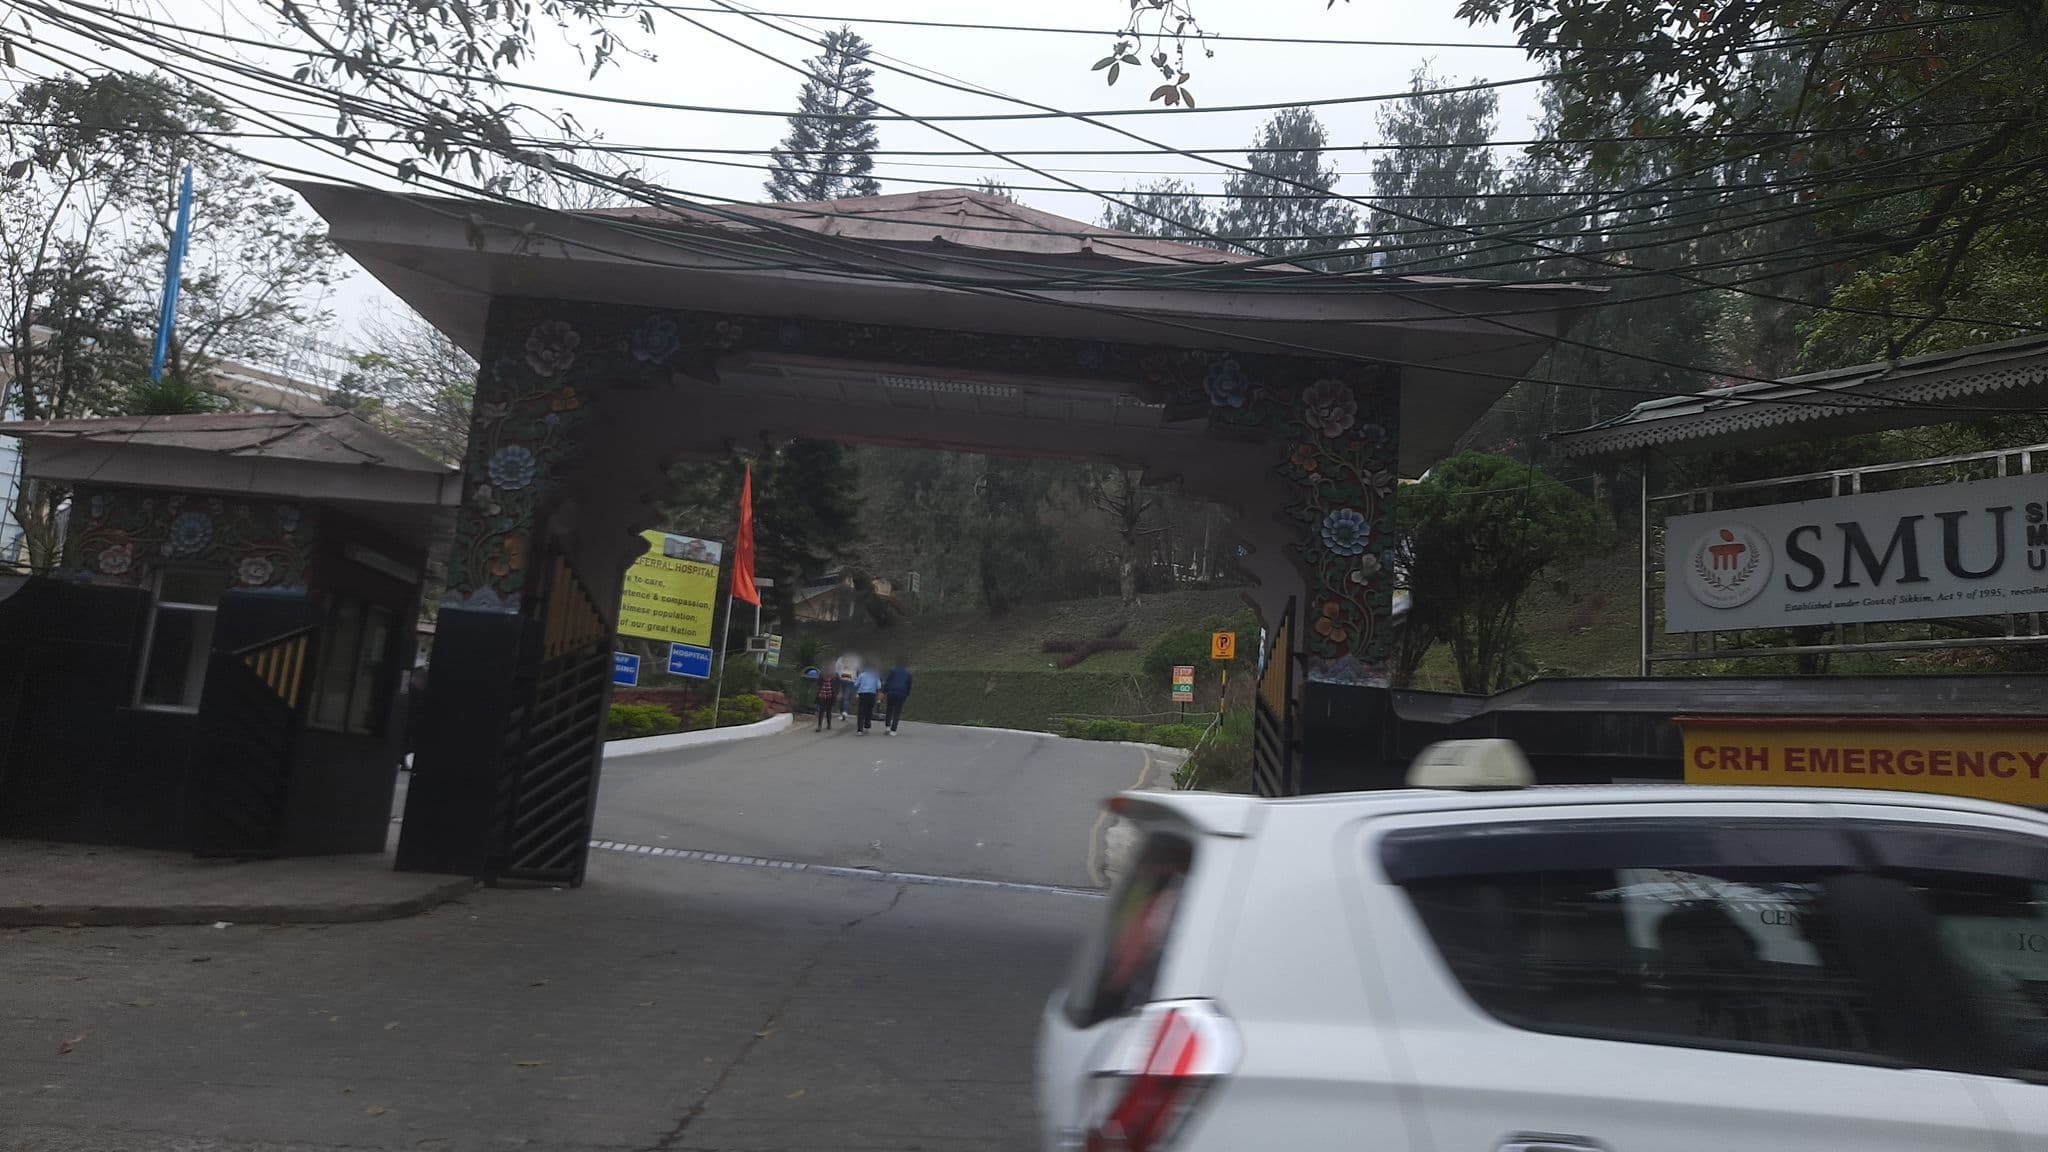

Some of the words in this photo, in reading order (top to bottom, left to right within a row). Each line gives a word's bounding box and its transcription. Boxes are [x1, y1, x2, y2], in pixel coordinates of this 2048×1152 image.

[1785, 506, 2012, 592] SMU
[675, 563, 715, 577] HOSPITAL
[645, 579, 665, 588] care,
[1937, 592, 1954, 601] Act
[1956, 591, 1963, 600] 9
[1966, 588, 1976, 600] of
[661, 597, 711, 610] compassion,
[631, 621, 645, 629] our
[647, 622, 669, 634] great
[671, 626, 697, 637] Nation
[672, 648, 709, 661] HOSPITAL
[1694, 745, 1769, 772] CRH
[1784, 746, 2048, 779] EMERGENCY
